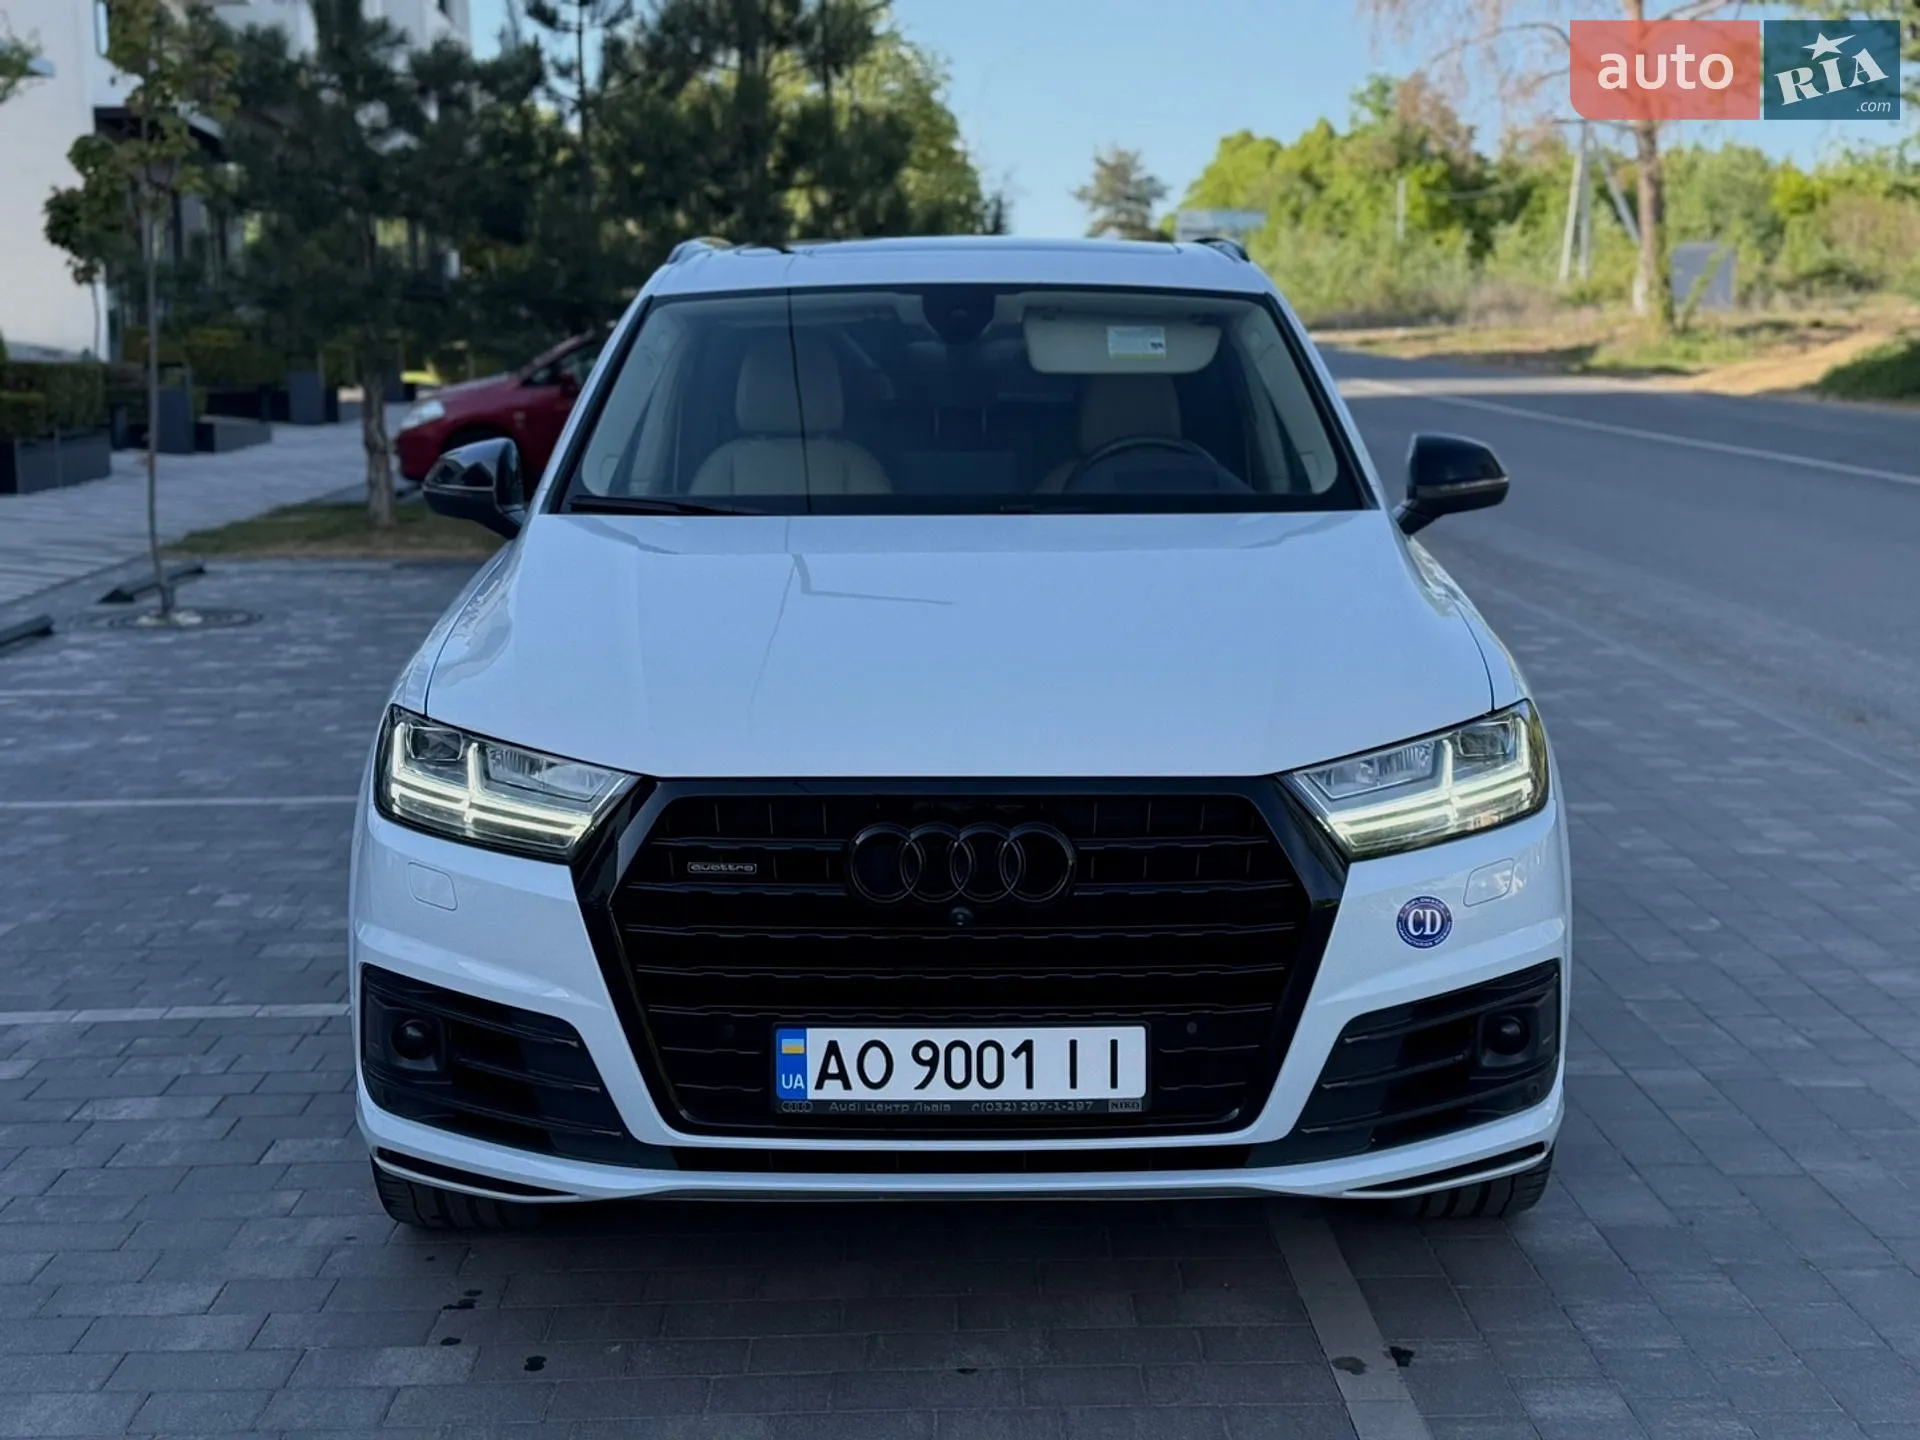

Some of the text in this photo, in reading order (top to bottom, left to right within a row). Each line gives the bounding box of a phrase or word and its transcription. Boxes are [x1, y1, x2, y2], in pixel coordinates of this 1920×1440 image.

[690, 863, 755, 872] quattro
[1408, 908, 1442, 936] CD
[814, 1039, 895, 1090] AO
[911, 1039, 1034, 1090] 9001
[781, 1073, 805, 1090] UA
[828, 1102, 861, 1112] Audi
